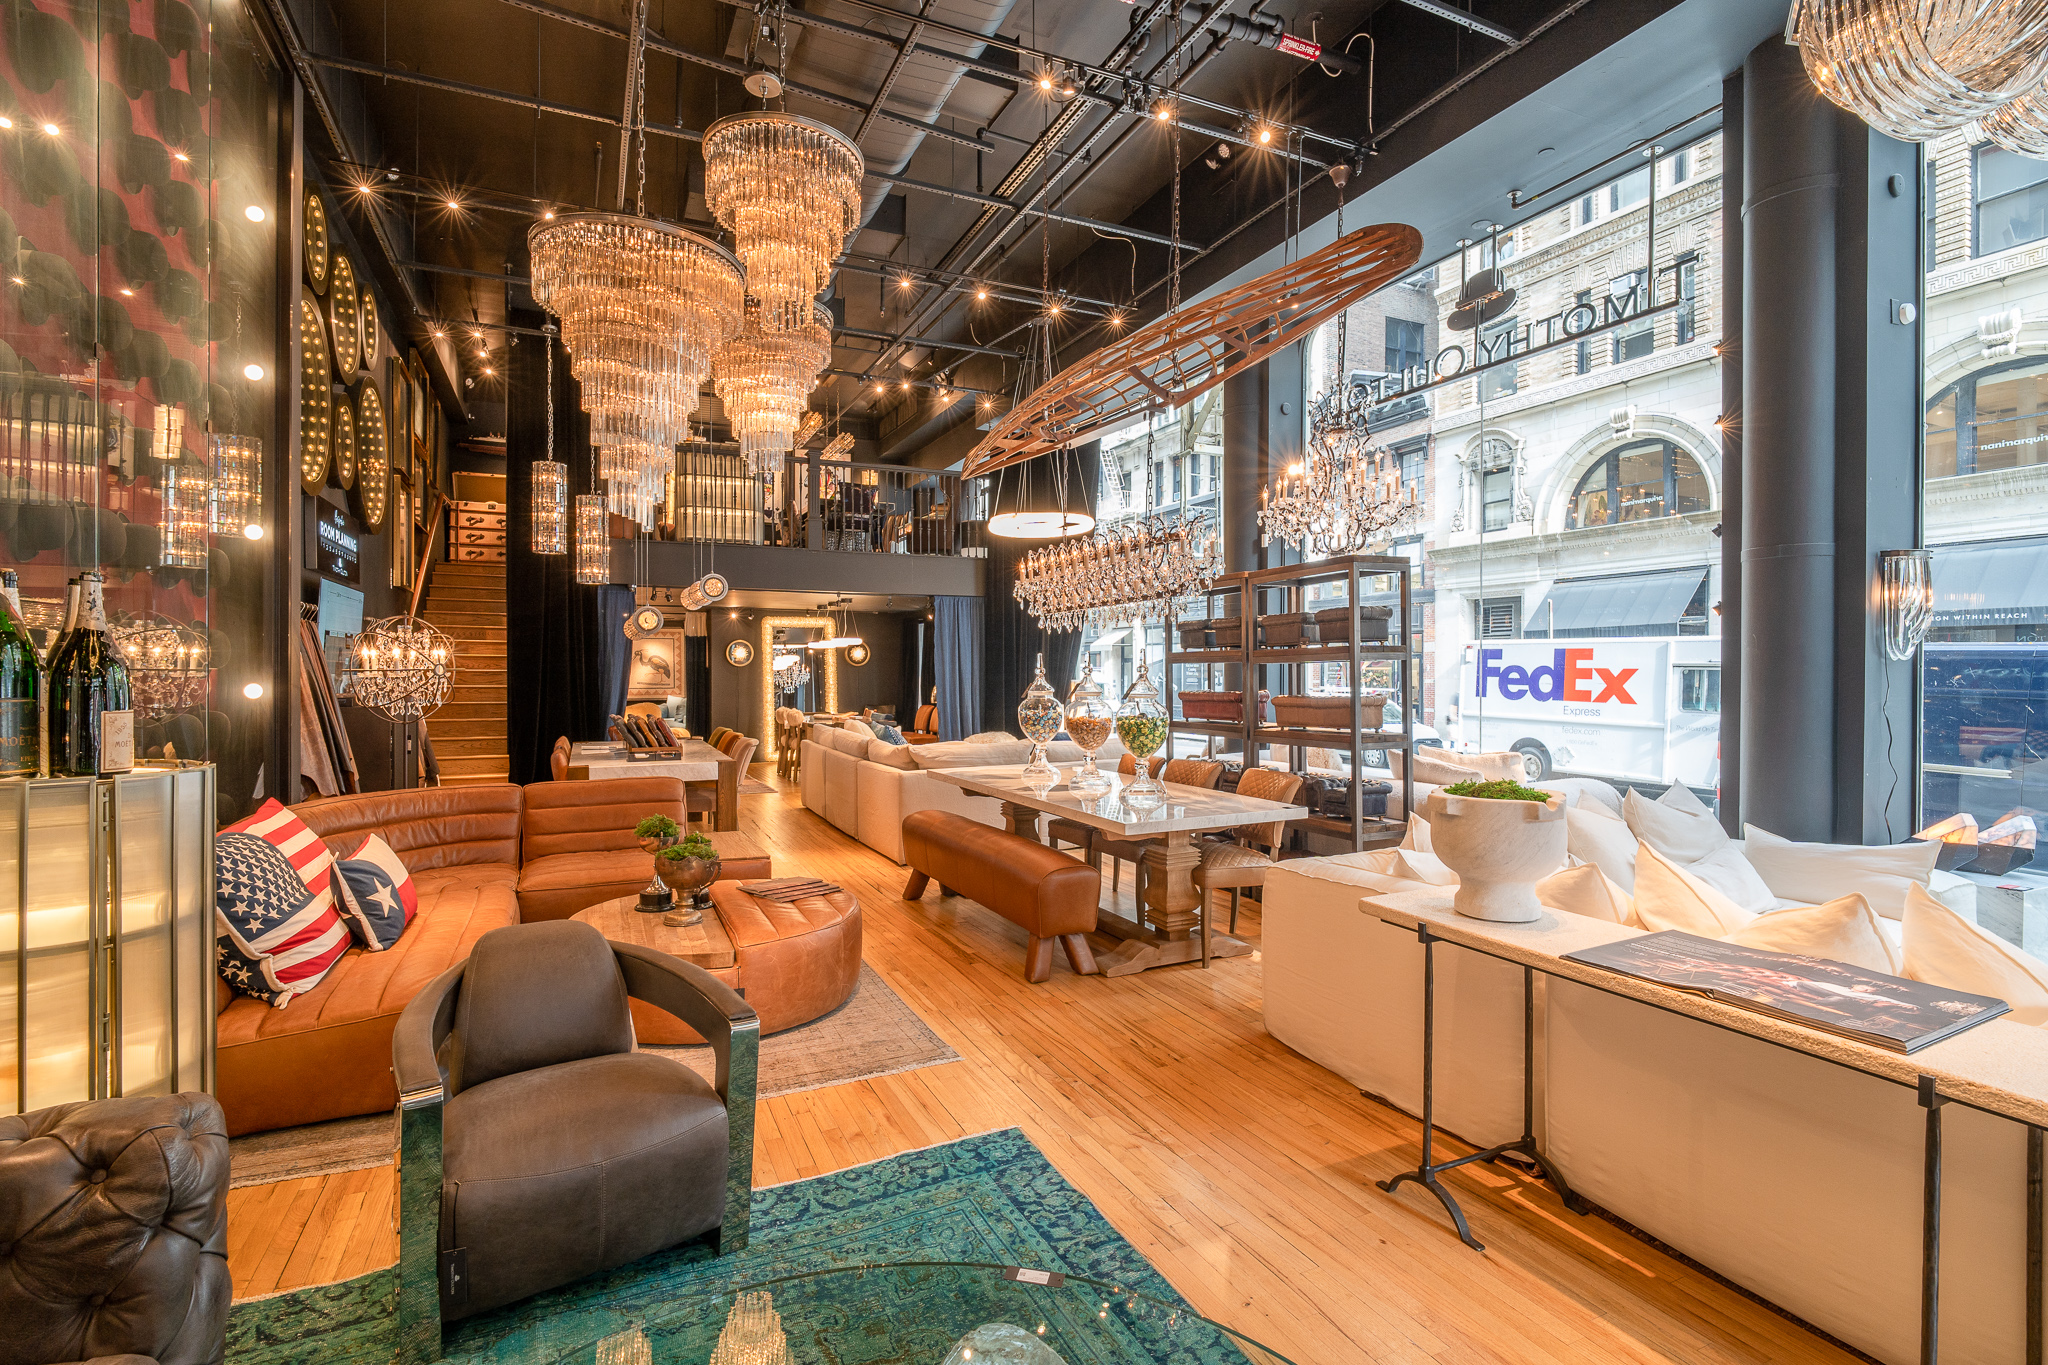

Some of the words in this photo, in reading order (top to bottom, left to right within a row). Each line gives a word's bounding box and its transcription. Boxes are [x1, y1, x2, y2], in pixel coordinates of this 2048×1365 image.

[320, 520, 335, 542] ROOM
[335, 529, 357, 552] PLANNING
[1953, 613, 1991, 621] WITHIN
[1476, 648, 1639, 704] FedEx
[1563, 705, 1601, 717] Express
[1561, 725, 1601, 736] fedex.com
